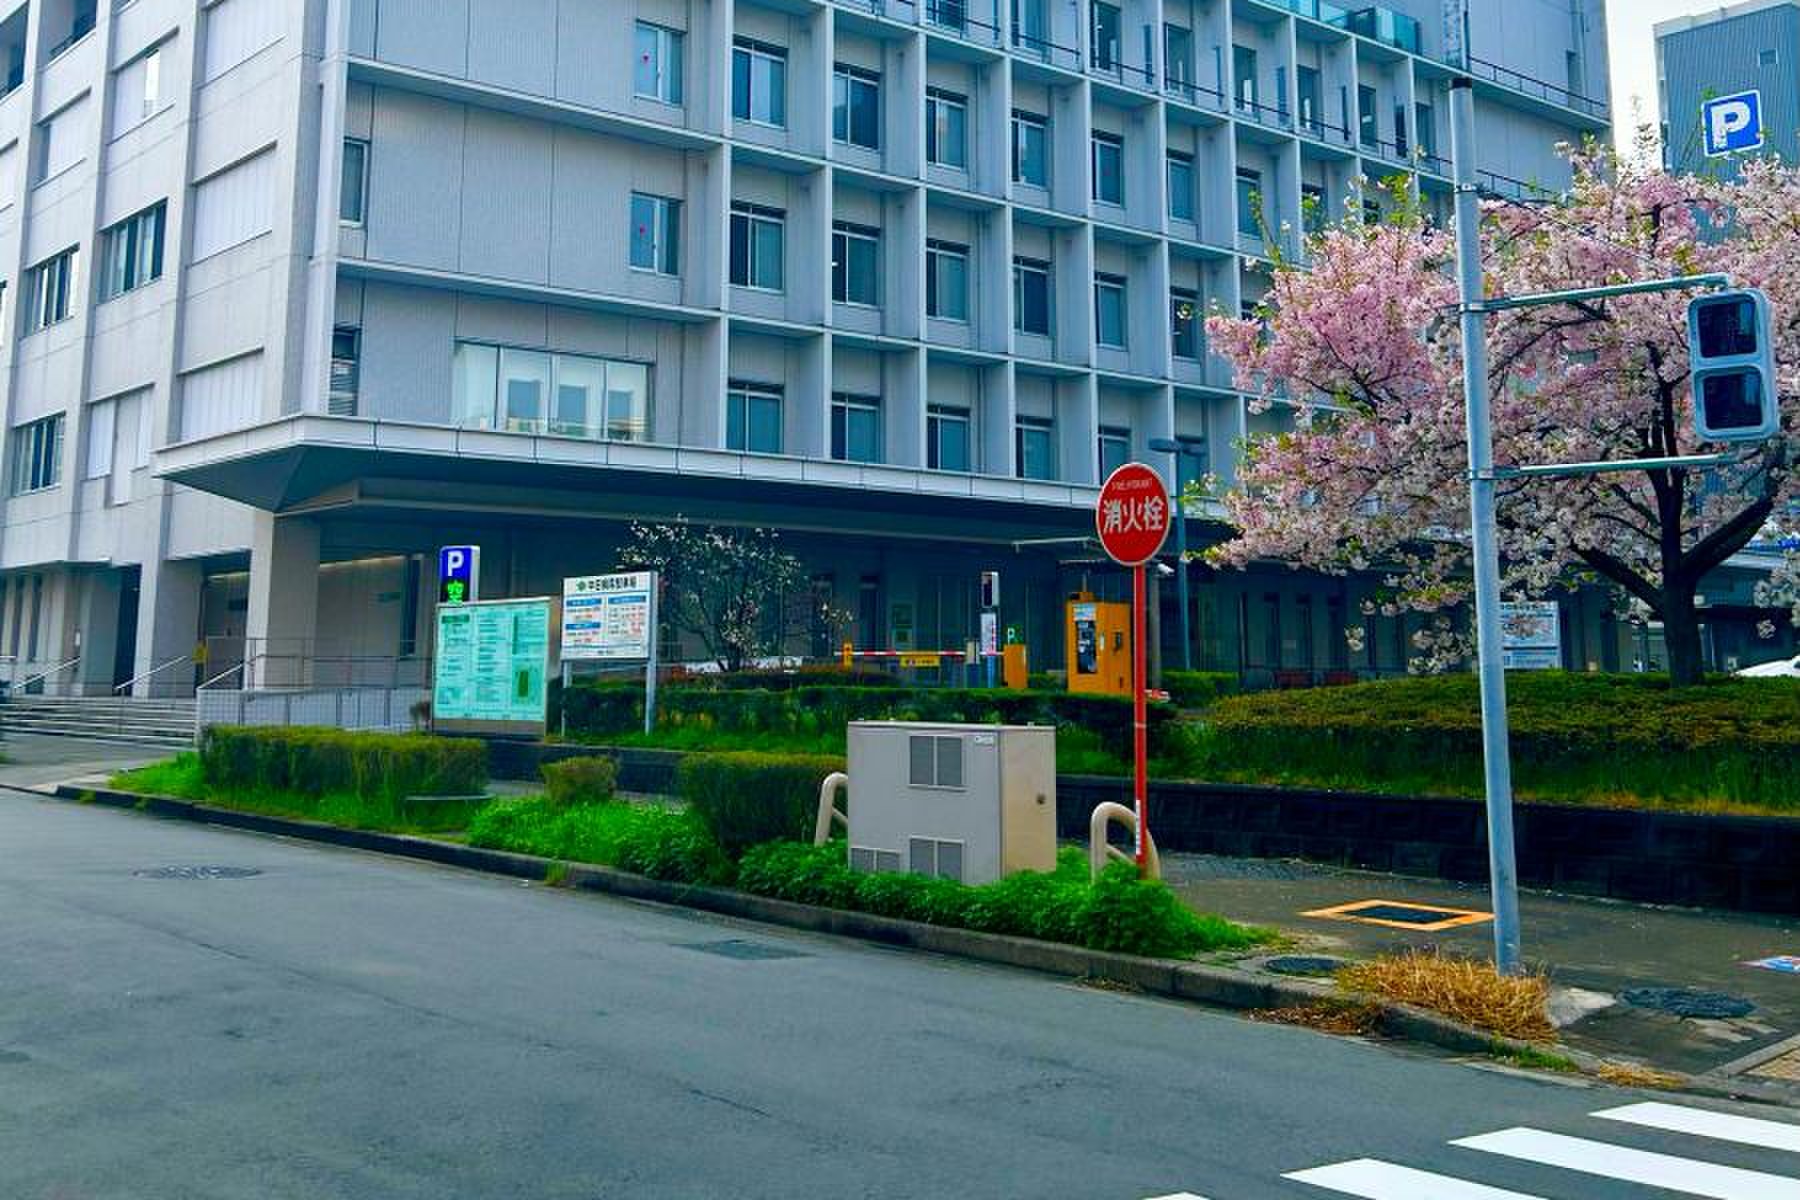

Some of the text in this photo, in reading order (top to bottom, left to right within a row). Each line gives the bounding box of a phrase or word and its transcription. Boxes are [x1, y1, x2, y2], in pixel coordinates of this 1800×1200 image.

[1711, 102, 1750, 150] P
[1103, 496, 1165, 533] 消火栓
[447, 550, 465, 577] P
